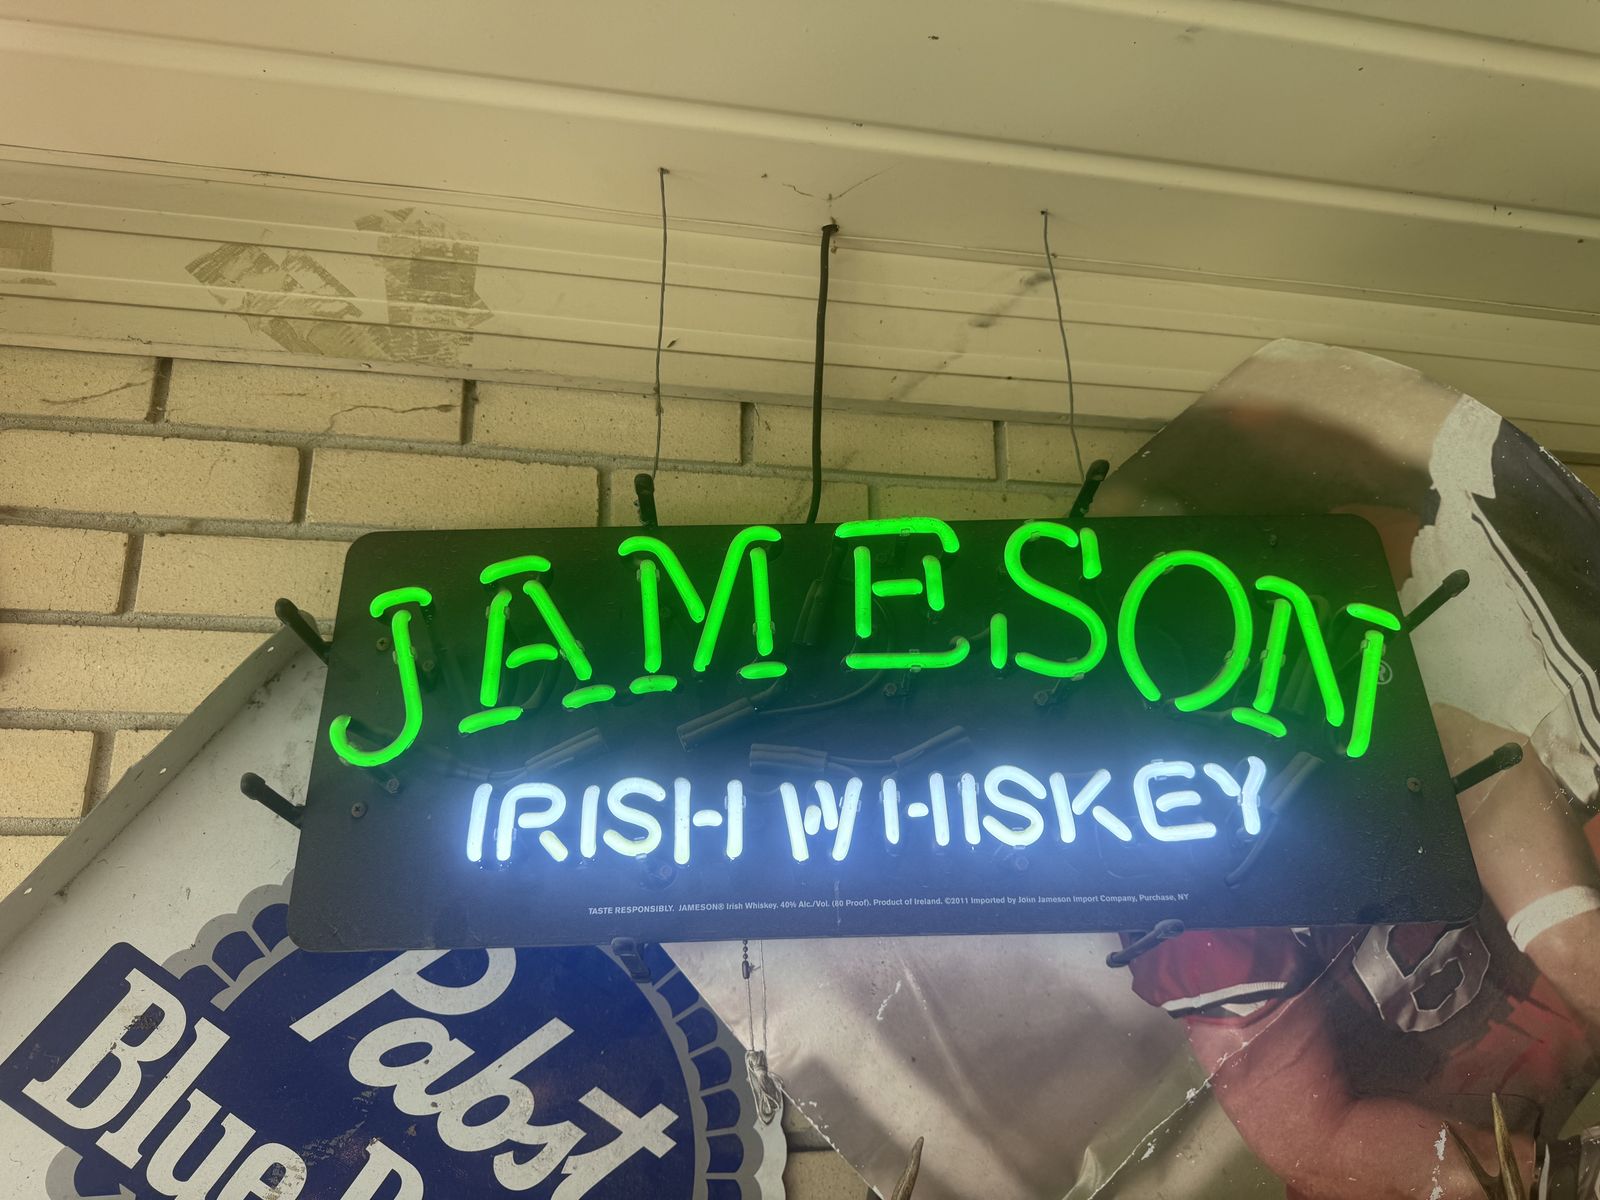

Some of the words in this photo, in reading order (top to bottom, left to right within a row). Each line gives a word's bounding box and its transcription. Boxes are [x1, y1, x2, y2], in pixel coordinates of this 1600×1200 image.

[329, 517, 1401, 757] JAMESON
[466, 776, 744, 864] IRISH
[780, 755, 1267, 862] WHISKEY
[588, 906, 613, 915] TASTE
[614, 904, 675, 914] RESPONSIBLY.
[726, 902, 743, 910] Irish
[780, 901, 797, 909] 40%
[831, 899, 844, 909] (80
[845, 898, 872, 908] Proof).
[873, 898, 903, 907] Product
[904, 897, 913, 906] of
[914, 897, 943, 906] Ireland.
[970, 896, 1005, 906] Imported
[1007, 896, 1016, 905] by
[1018, 895, 1036, 903] John
[1037, 895, 1071, 903] Jameson
[1073, 894, 1099, 904] Import
[1100, 894, 1138, 903] Company,
[1177, 893, 1190, 901] NY
[22, 968, 308, 1200] Blue
[289, 948, 679, 1200] Pabst
